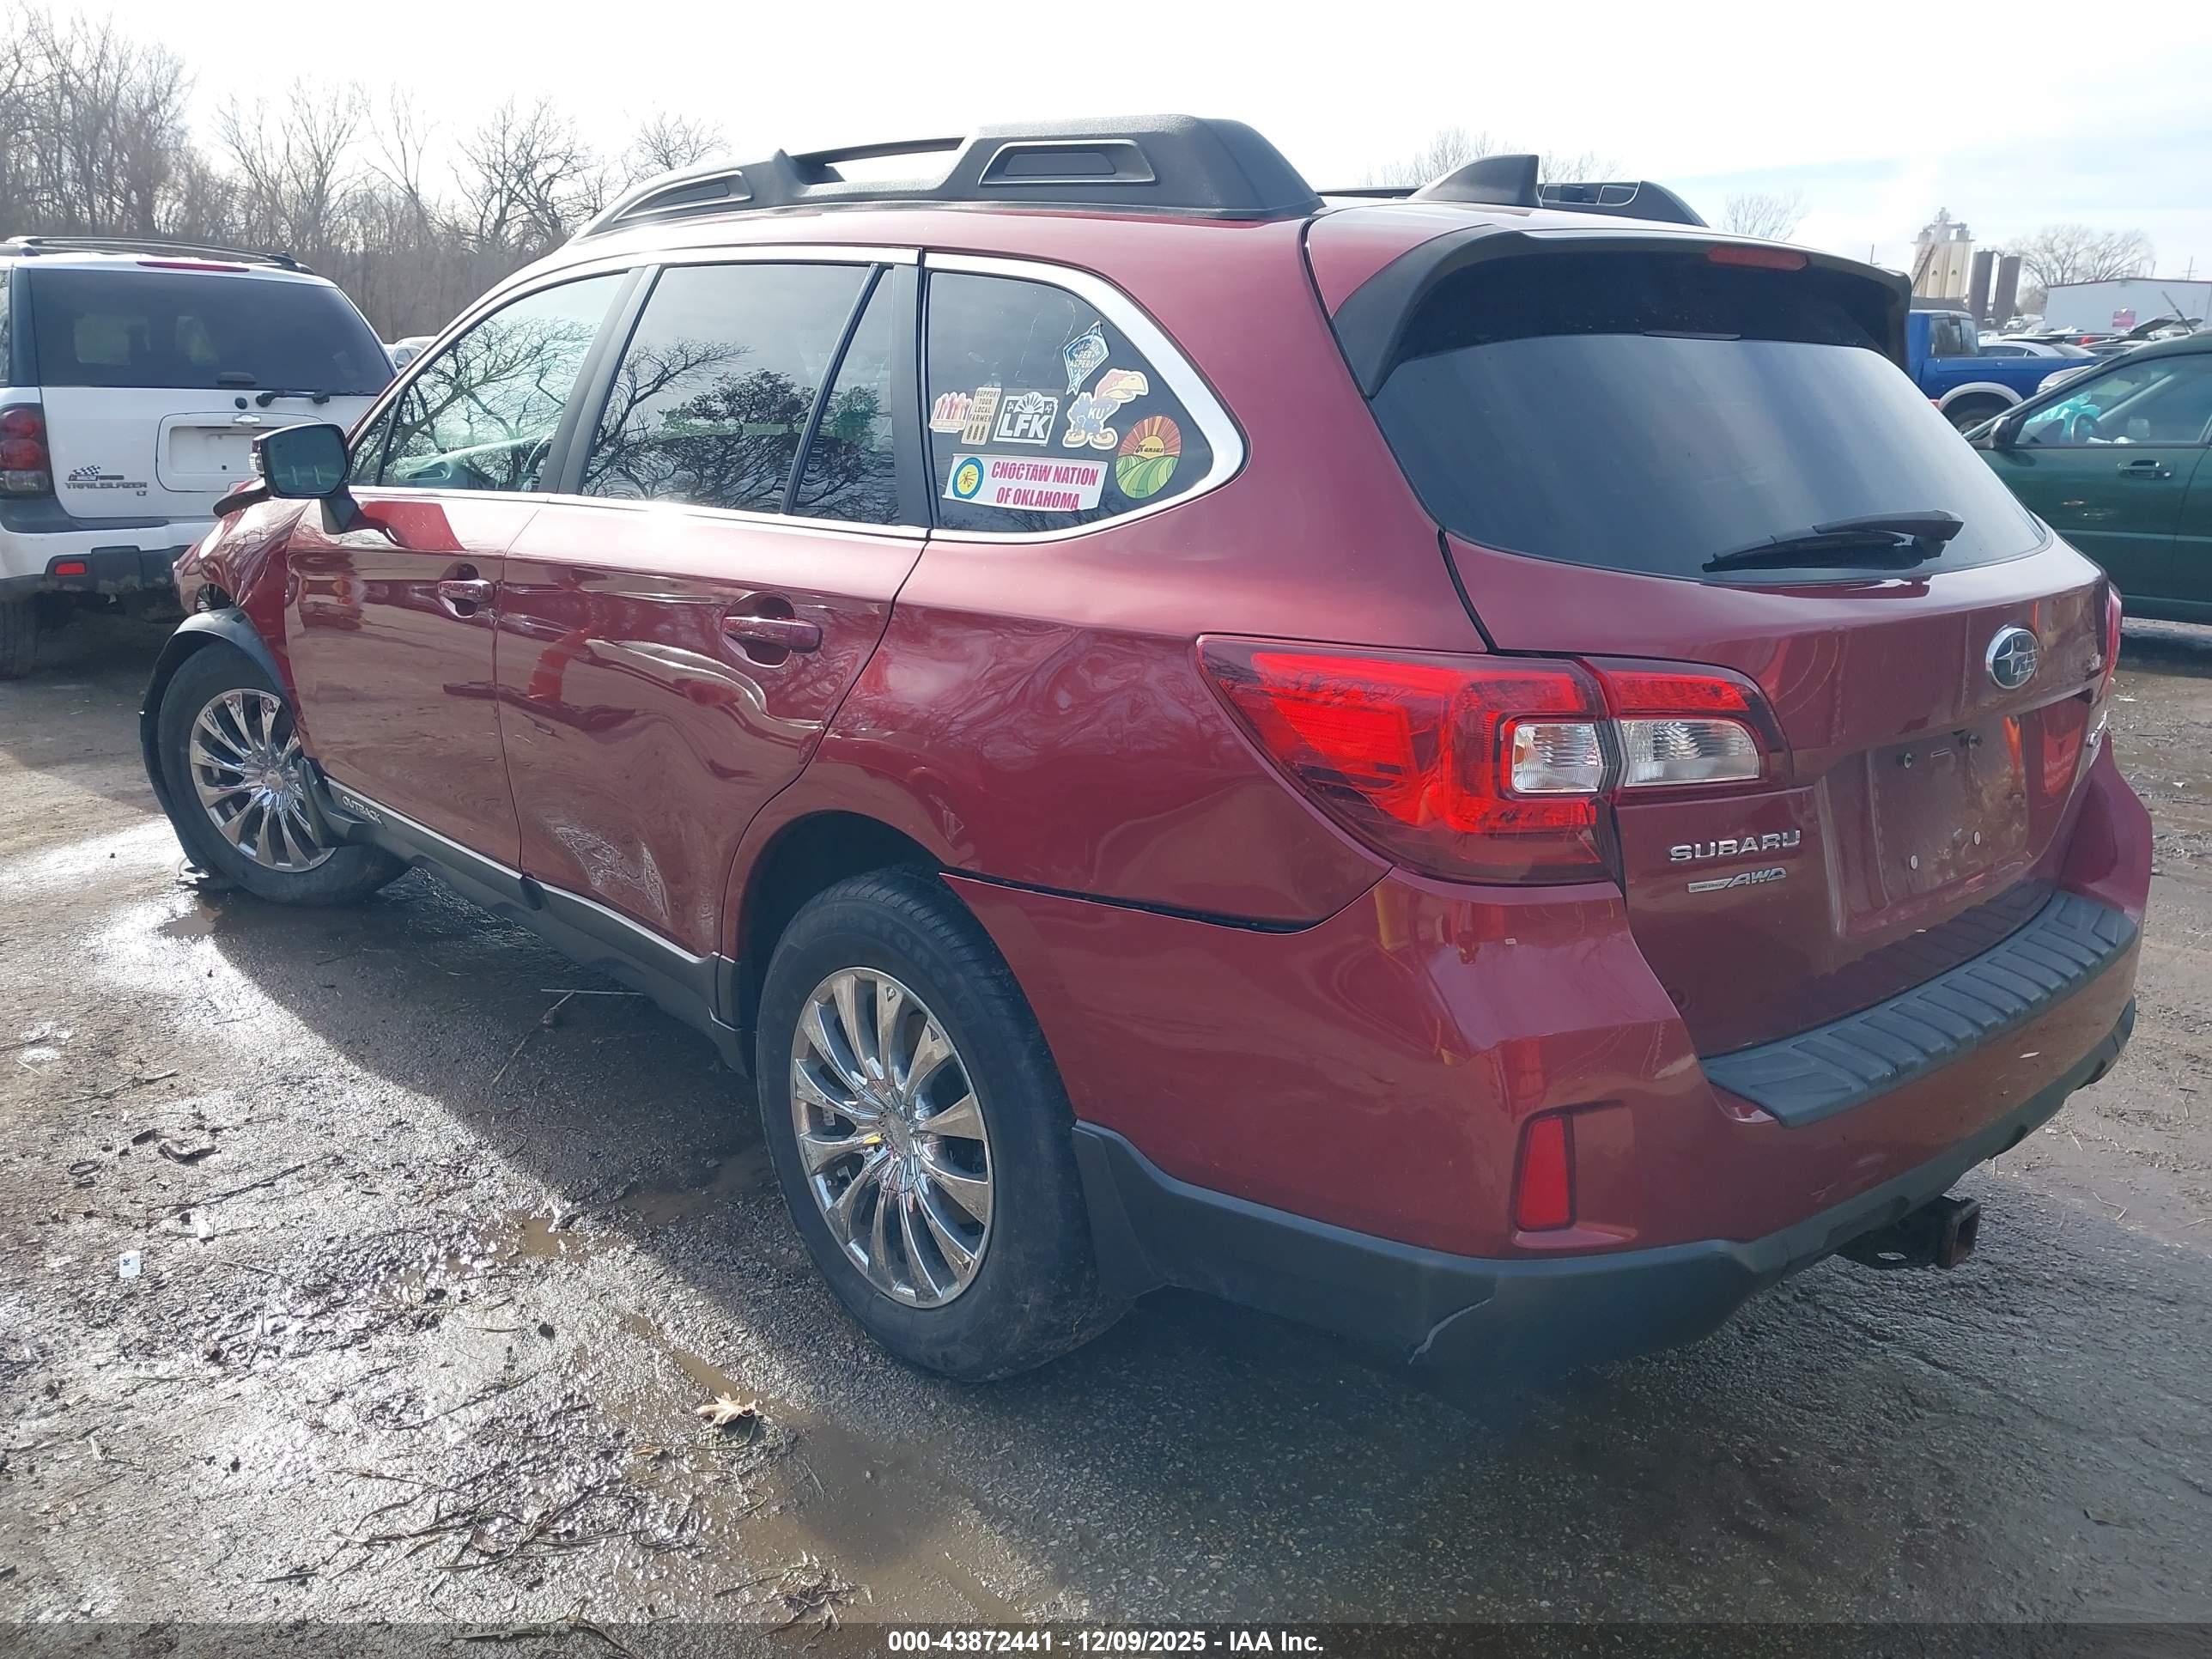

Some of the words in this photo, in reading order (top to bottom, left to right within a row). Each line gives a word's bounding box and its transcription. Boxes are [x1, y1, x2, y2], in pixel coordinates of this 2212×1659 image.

[969, 414, 992, 422] FARMER
[1088, 407, 1104, 420] KU
[999, 413, 1052, 439] LFK
[1134, 444, 1164, 453] Kansas
[991, 461, 1053, 483] CHOCTAW
[1052, 465, 1099, 486] NATION
[996, 487, 1011, 504] OF
[1012, 488, 1079, 509] OKLAHOMA
[343, 796, 382, 824] OUTBACK
[1670, 830, 1801, 861] SUBARU
[1727, 867, 1787, 888] AWD
